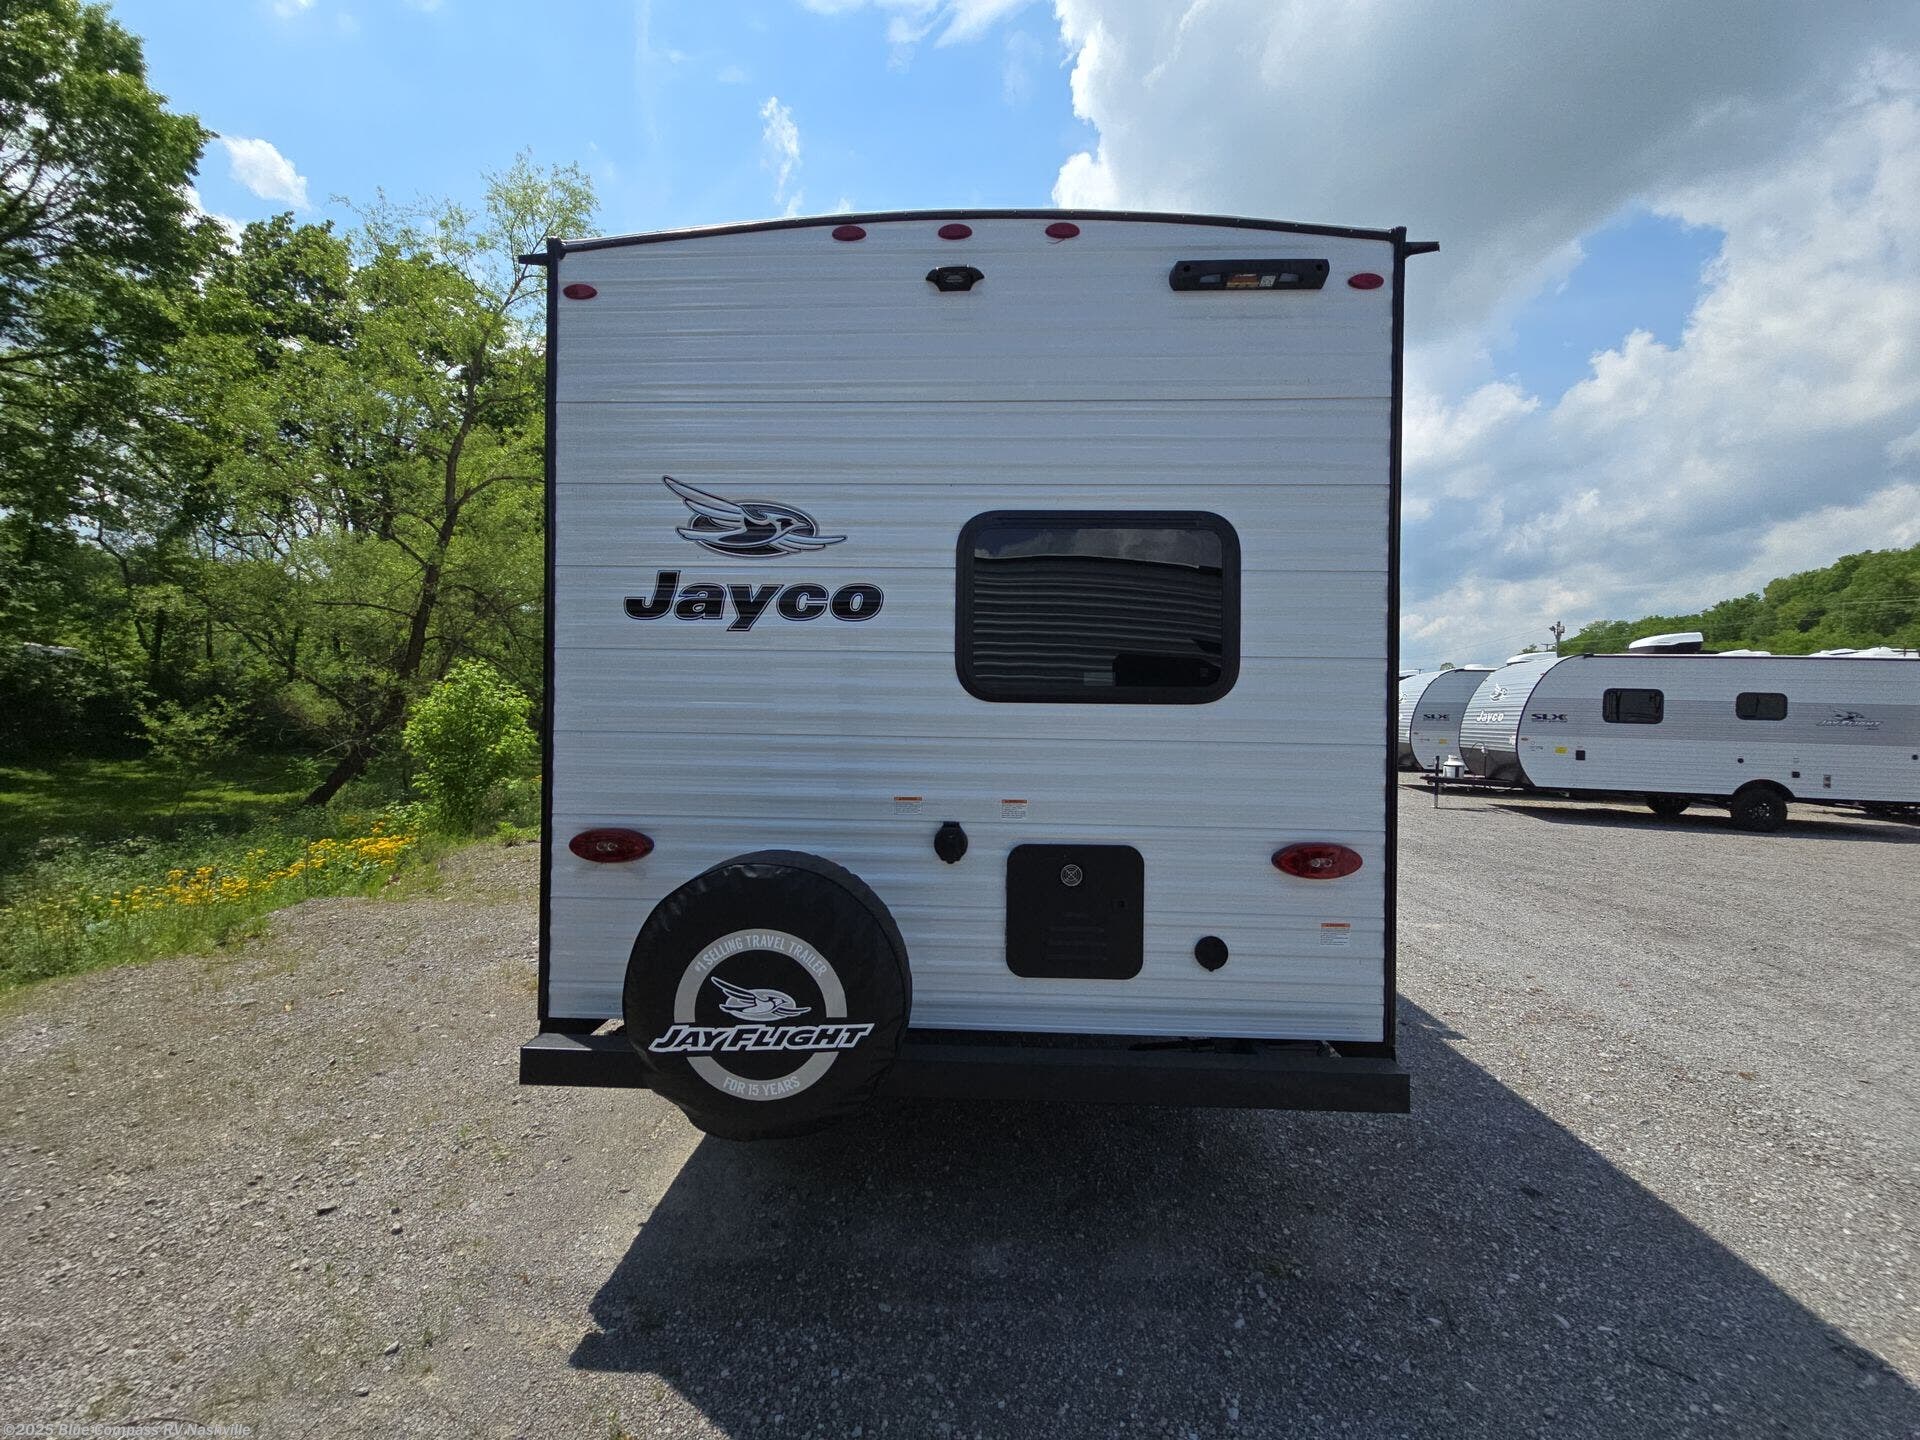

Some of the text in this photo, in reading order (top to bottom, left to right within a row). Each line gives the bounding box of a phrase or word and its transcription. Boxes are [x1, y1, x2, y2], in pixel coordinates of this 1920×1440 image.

[623, 569, 885, 632] Jayco
[1476, 710, 1505, 724] Jayco
[1531, 713, 1568, 723] SLX
[703, 937, 743, 966] SELLING
[746, 934, 785, 951] TRAVEL
[788, 941, 828, 977] TRAILER
[723, 1075, 801, 1096] FOR 15 YEARS
